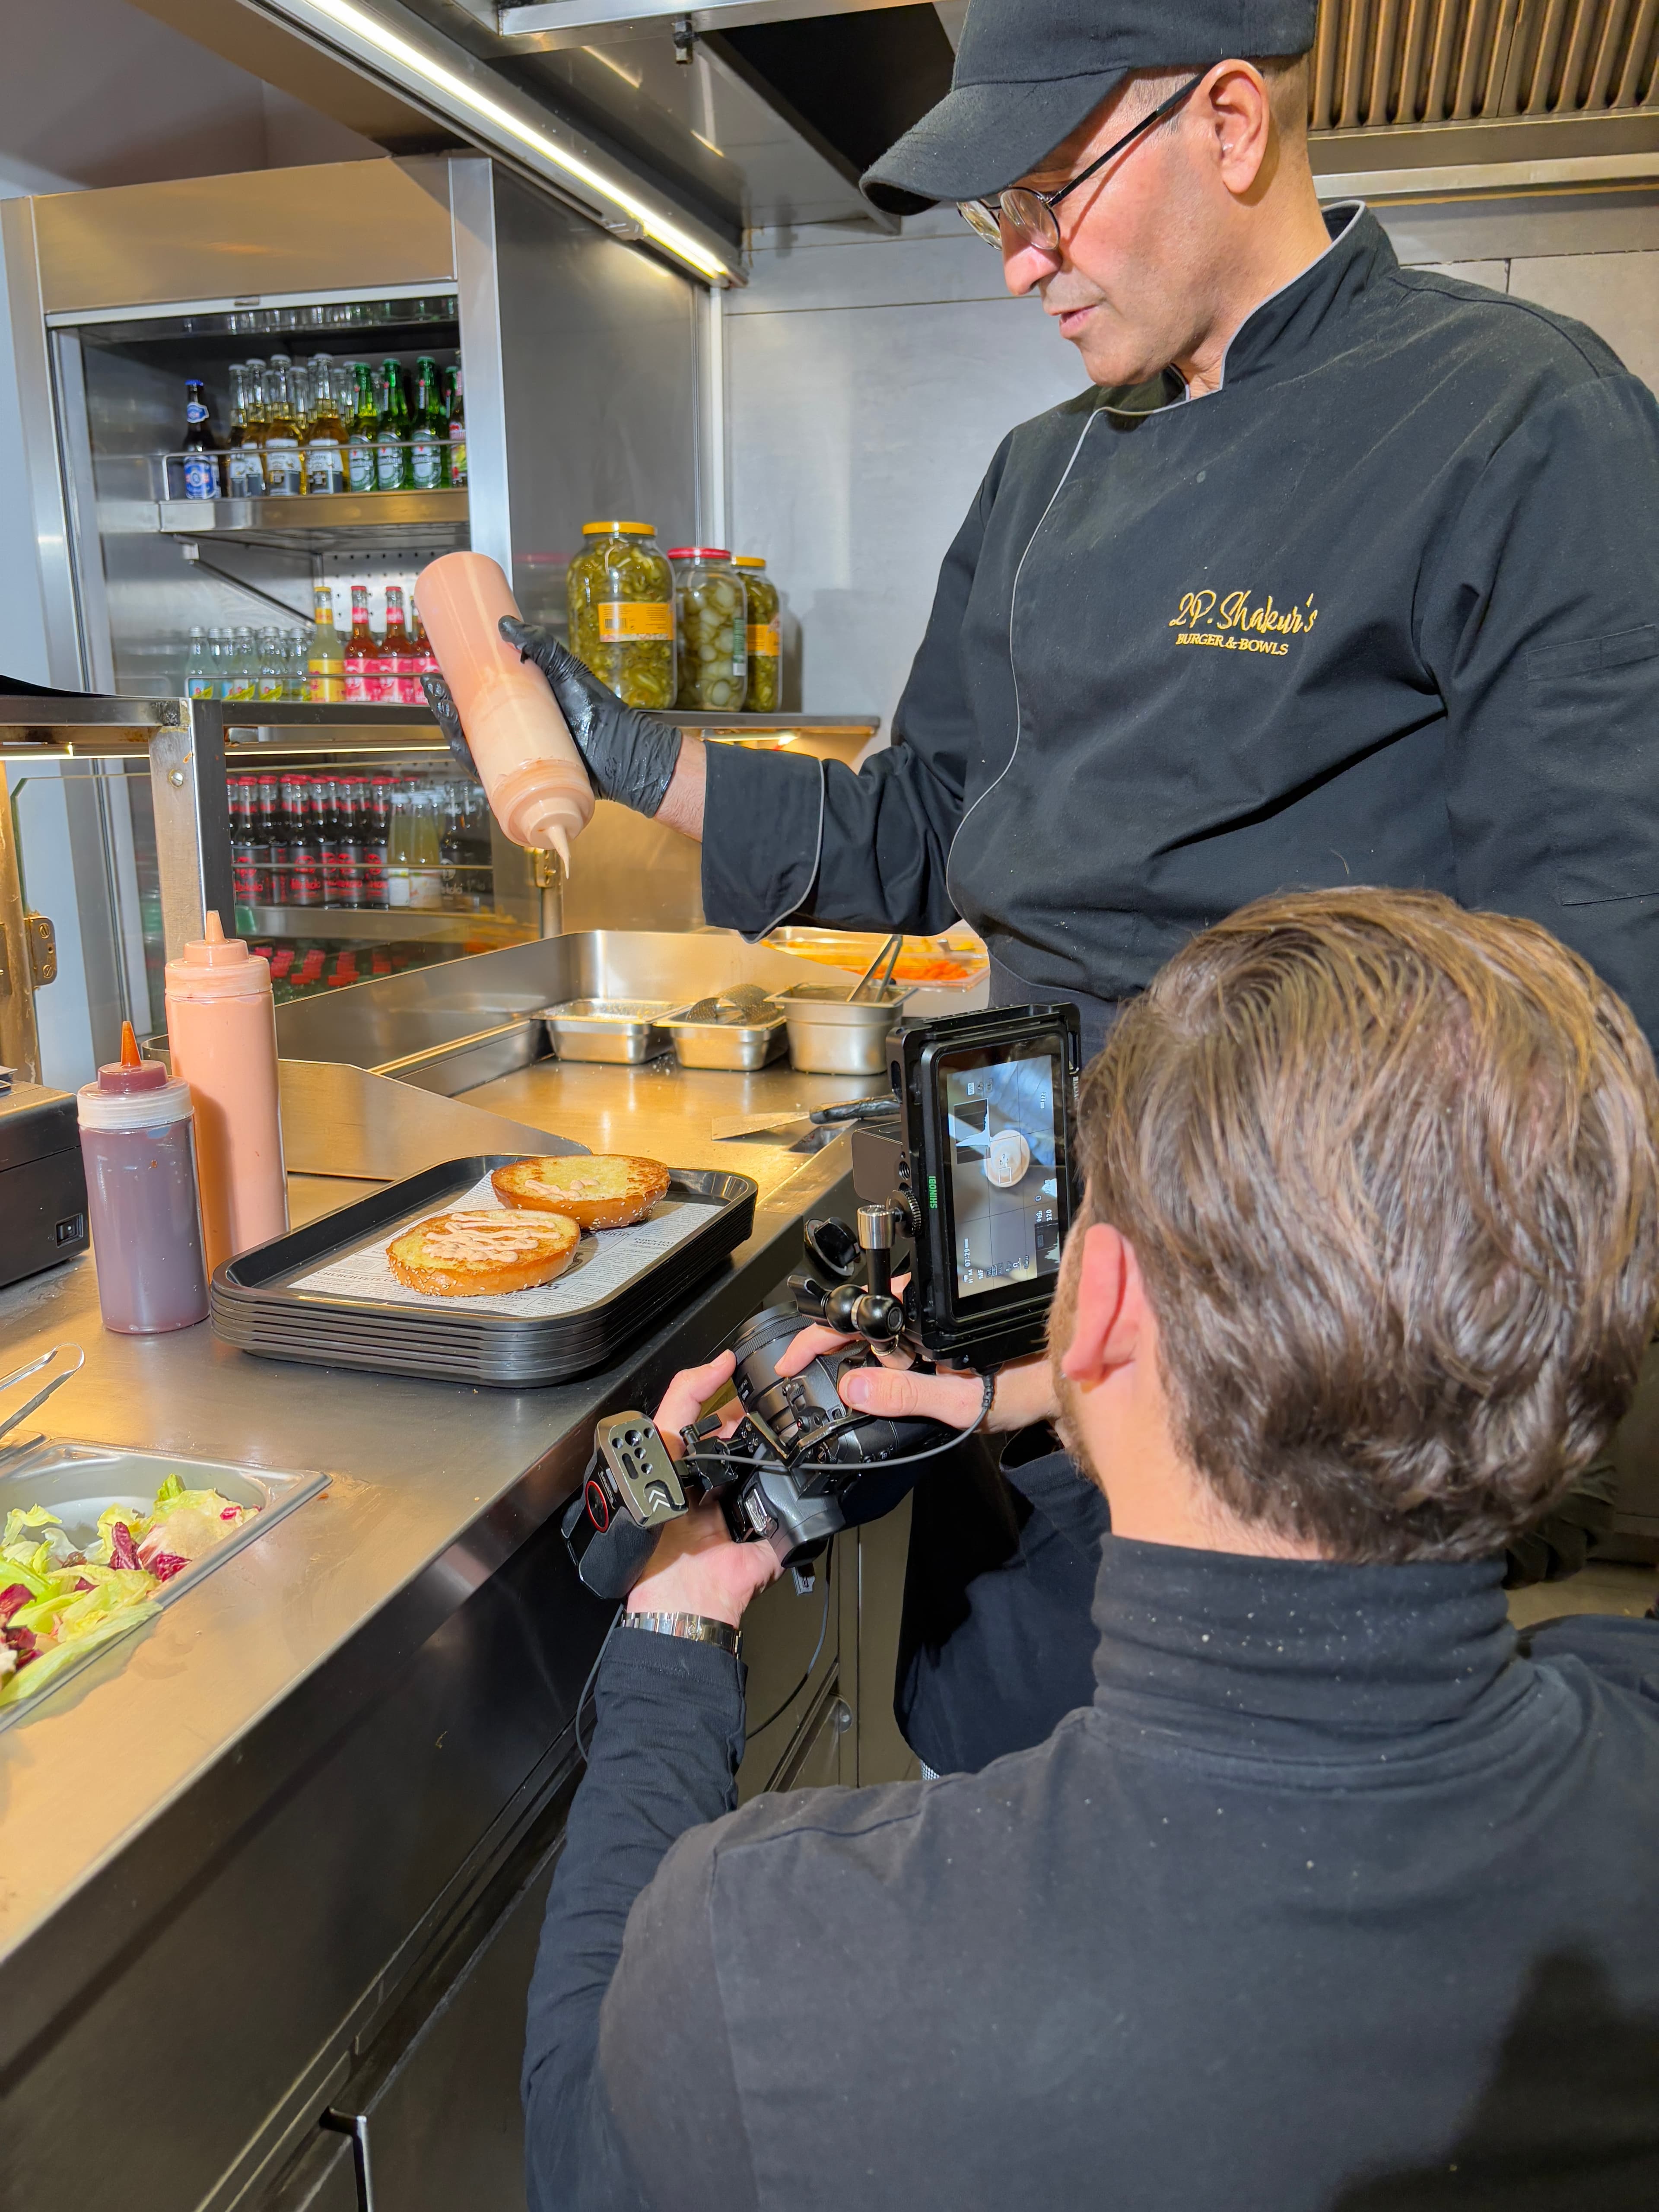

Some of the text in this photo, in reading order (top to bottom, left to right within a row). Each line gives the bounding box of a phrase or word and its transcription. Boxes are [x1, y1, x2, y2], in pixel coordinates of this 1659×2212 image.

[1176, 632, 1289, 656] BURGER & BOWLS
[928, 1175, 938, 1209] SHINOBI
[317, 1271, 357, 1279] CHURCH
[978, 1269, 984, 1279] MF
